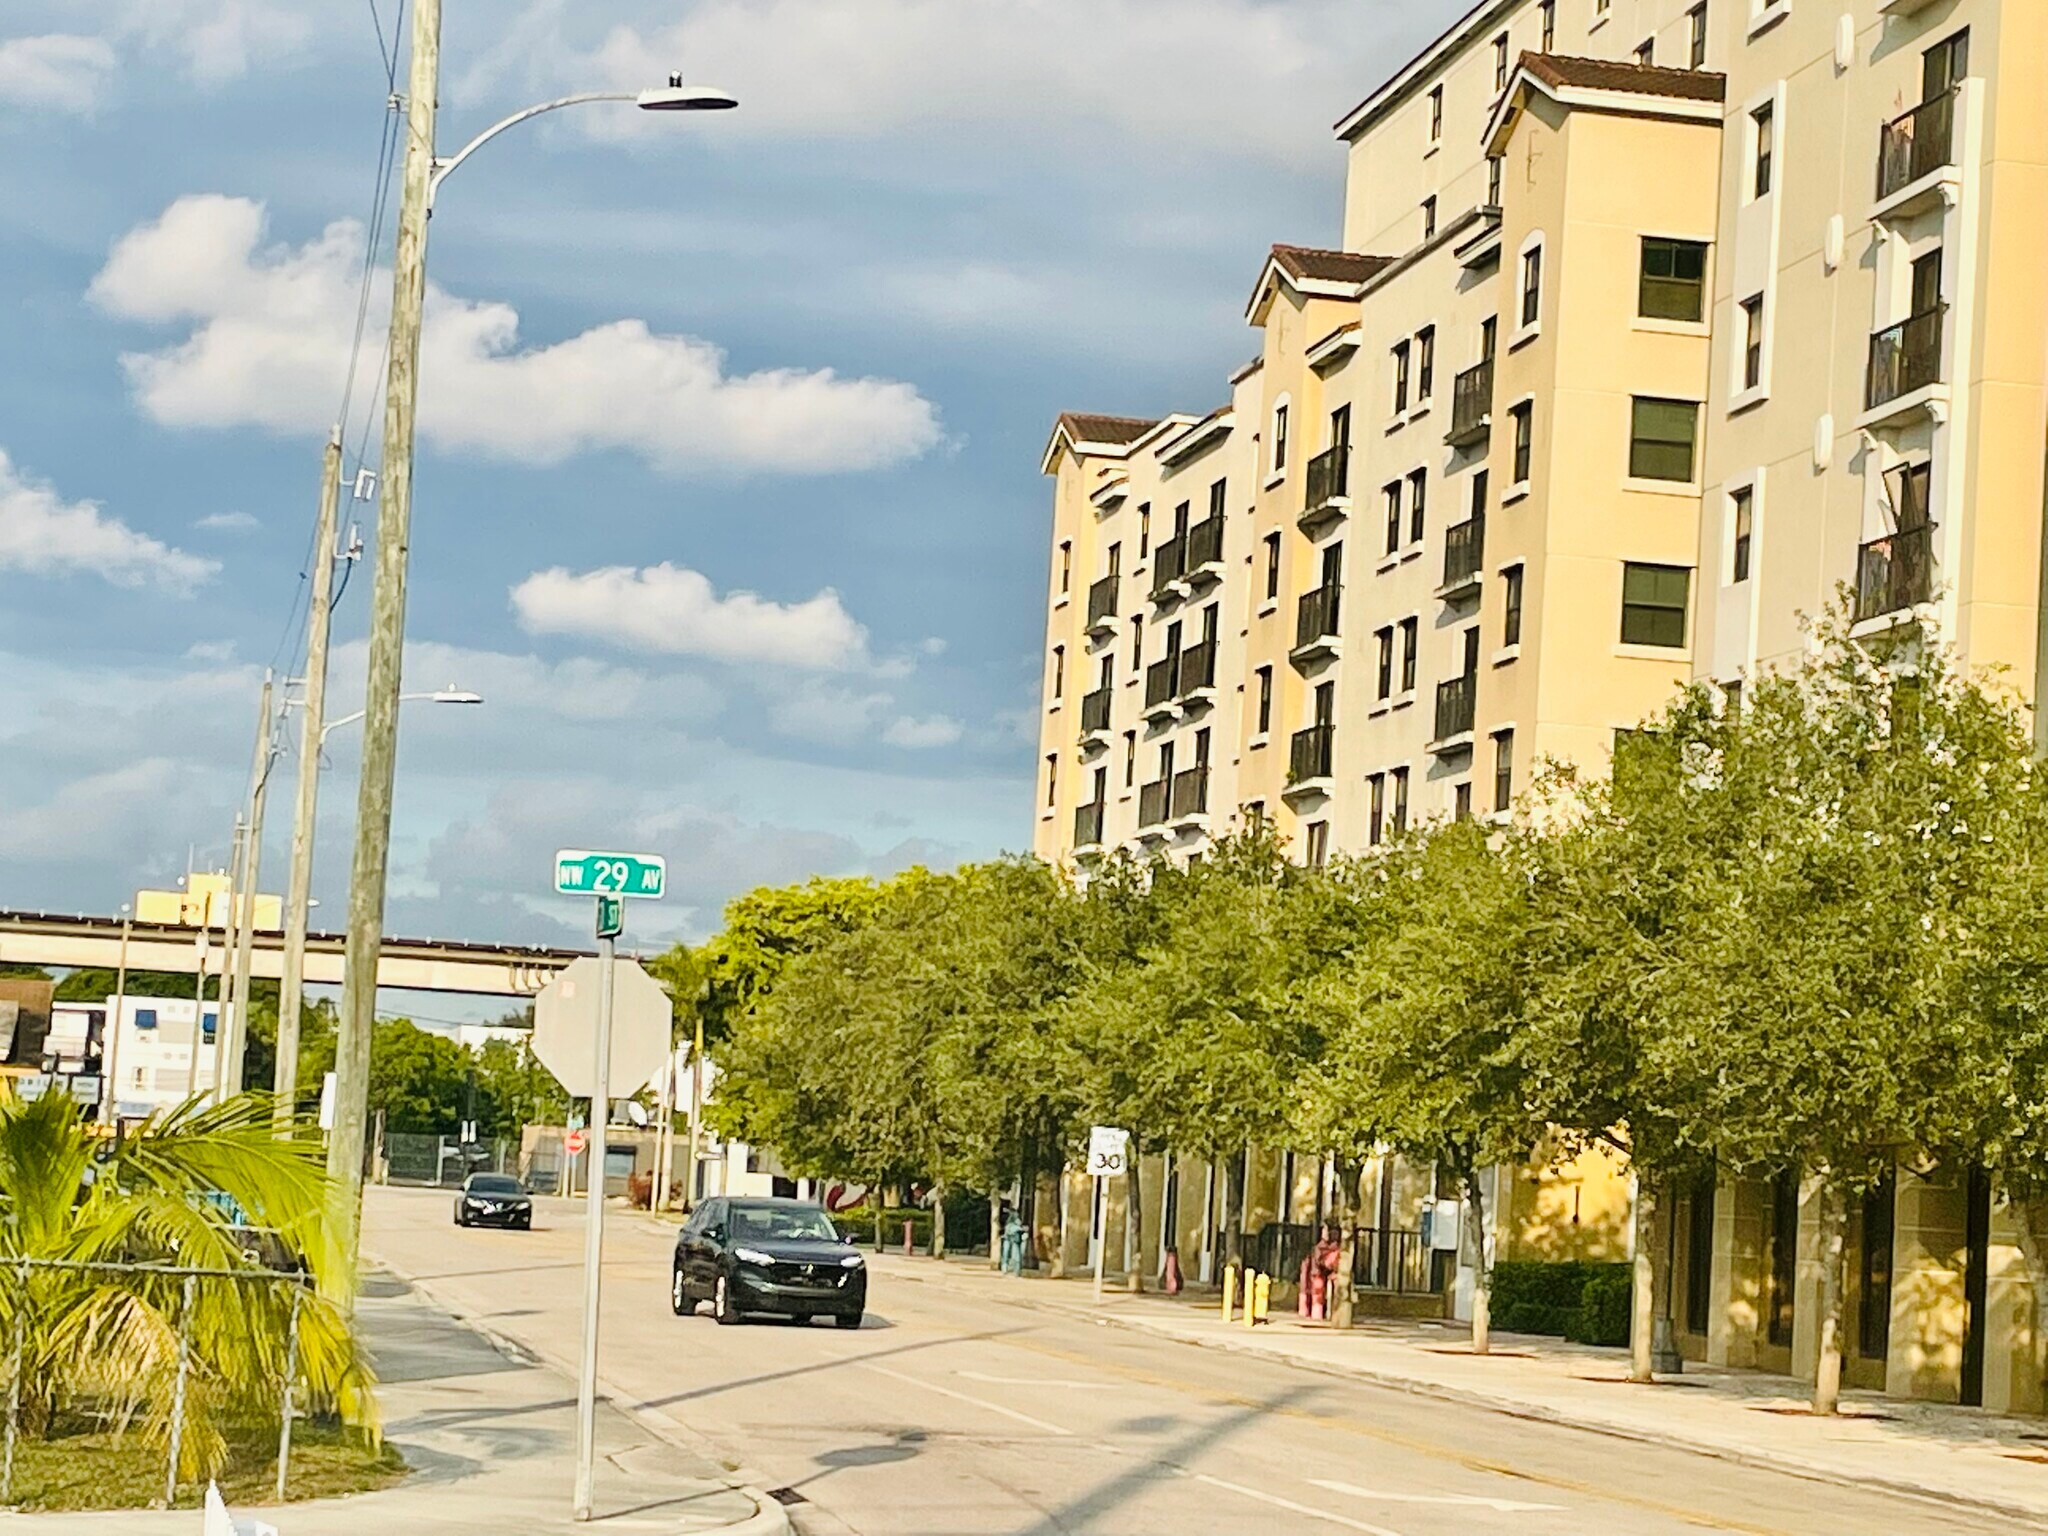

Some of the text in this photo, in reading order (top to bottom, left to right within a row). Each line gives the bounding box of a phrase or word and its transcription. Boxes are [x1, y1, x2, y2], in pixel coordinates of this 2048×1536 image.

[560, 860, 661, 892] NW 29 AV
[1095, 1153, 1120, 1170] 30
